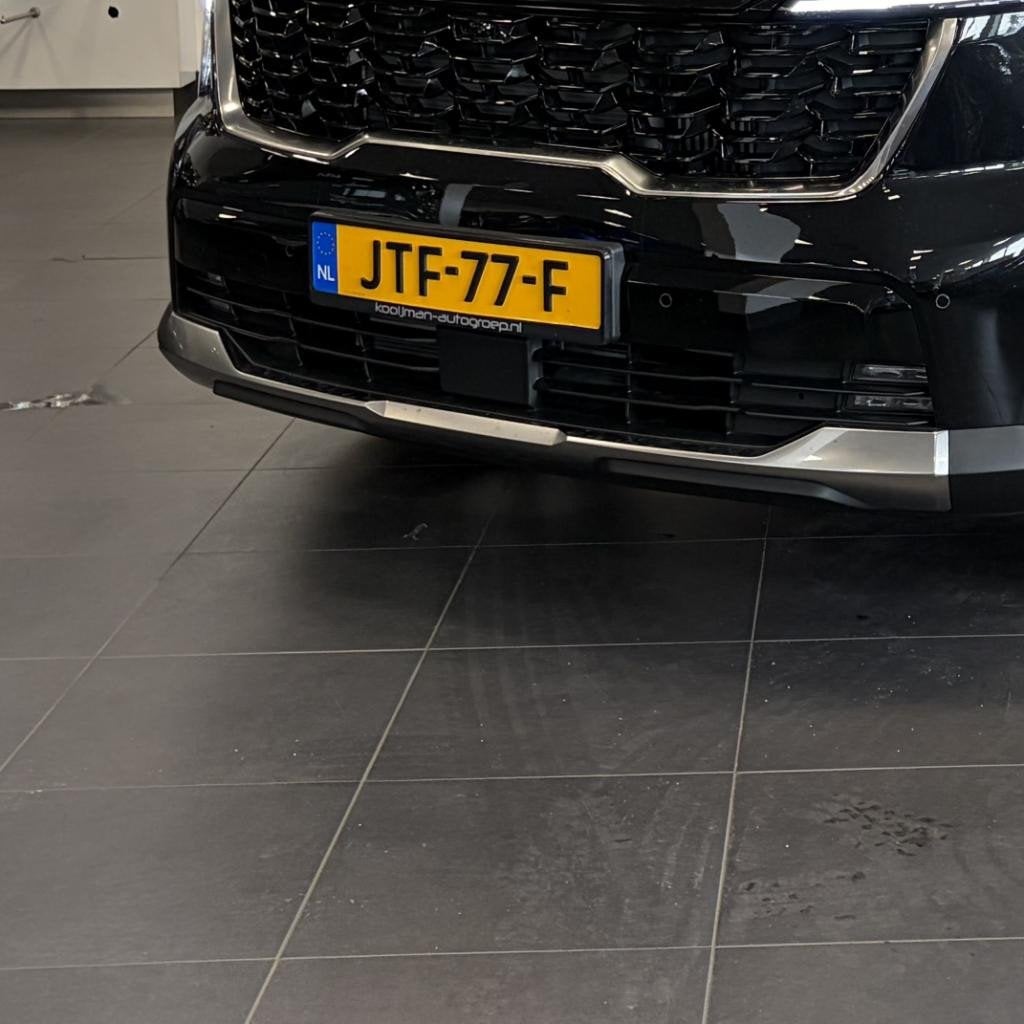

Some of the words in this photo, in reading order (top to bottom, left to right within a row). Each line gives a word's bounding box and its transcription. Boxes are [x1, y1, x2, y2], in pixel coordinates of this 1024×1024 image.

[317, 264, 335, 282] NL
[360, 240, 569, 313] JTF-77-F
[375, 302, 522, 333] kooijman-autogroep.nl
